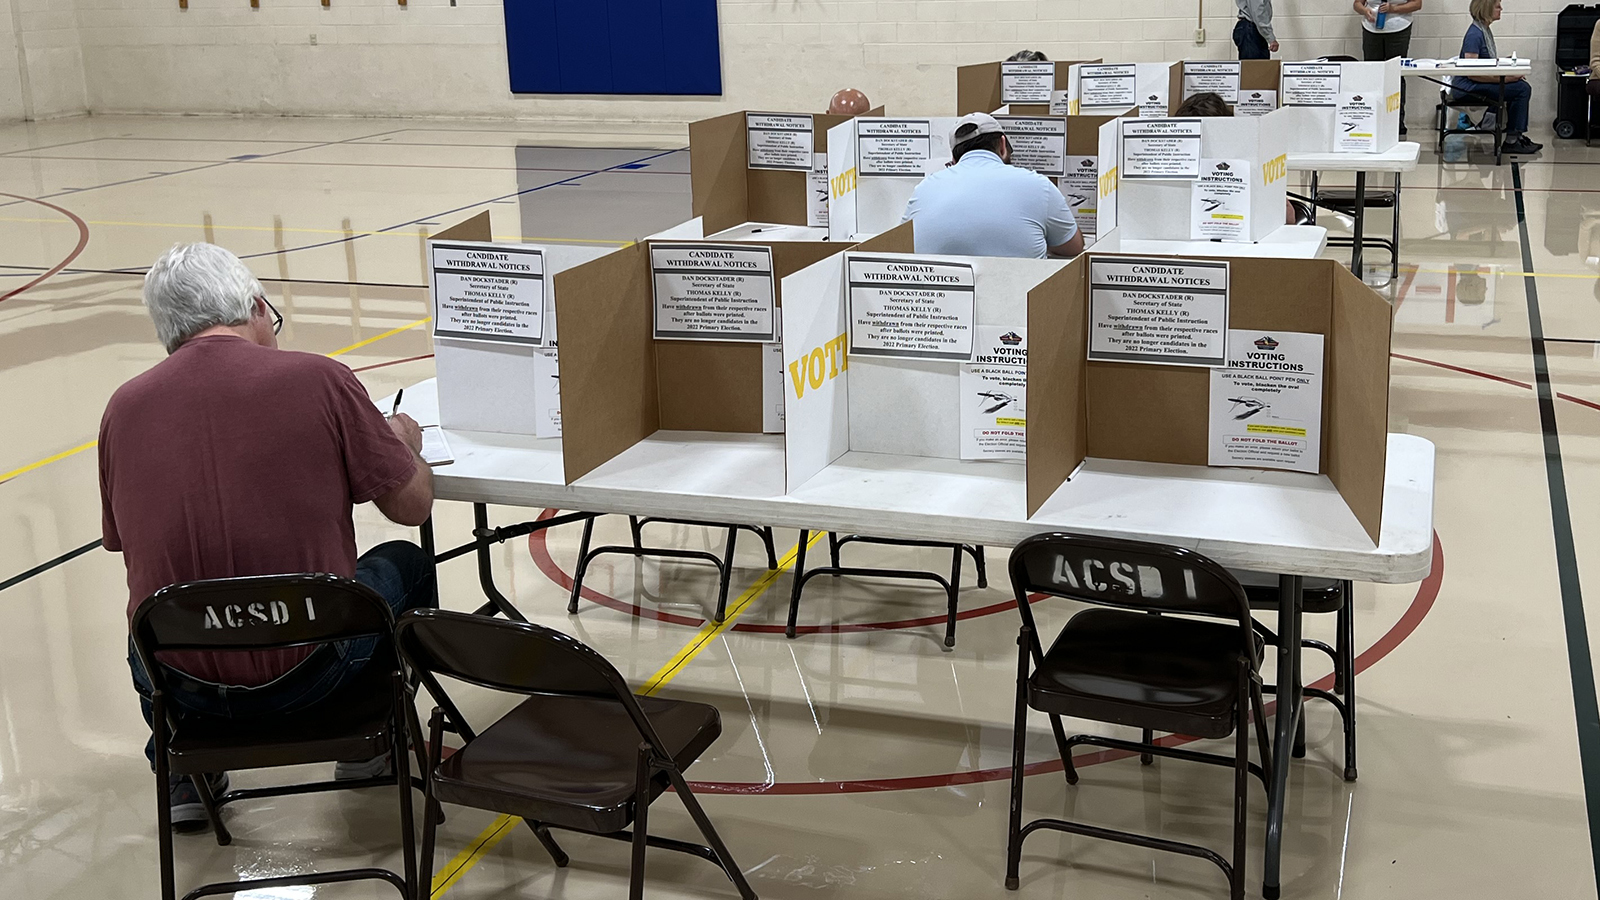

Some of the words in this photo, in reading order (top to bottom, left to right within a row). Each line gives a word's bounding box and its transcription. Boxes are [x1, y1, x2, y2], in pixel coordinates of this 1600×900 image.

[1263, 153, 1286, 186] VOTE
[446, 260, 496, 268] WITHDRAWAL
[887, 264, 934, 272] CANDIDATE
[864, 272, 922, 281] WITHDRAWAL
[1106, 275, 1169, 283] WITHDRAWAL
[993, 347, 1027, 356] VOTING
[976, 356, 1025, 364] INSTRUCTI
[1247, 352, 1285, 361] VOTING
[1228, 360, 1304, 371] INSTRUCTIONS
[1052, 555, 1164, 598] ACSD
[205, 601, 289, 629] ACSD
